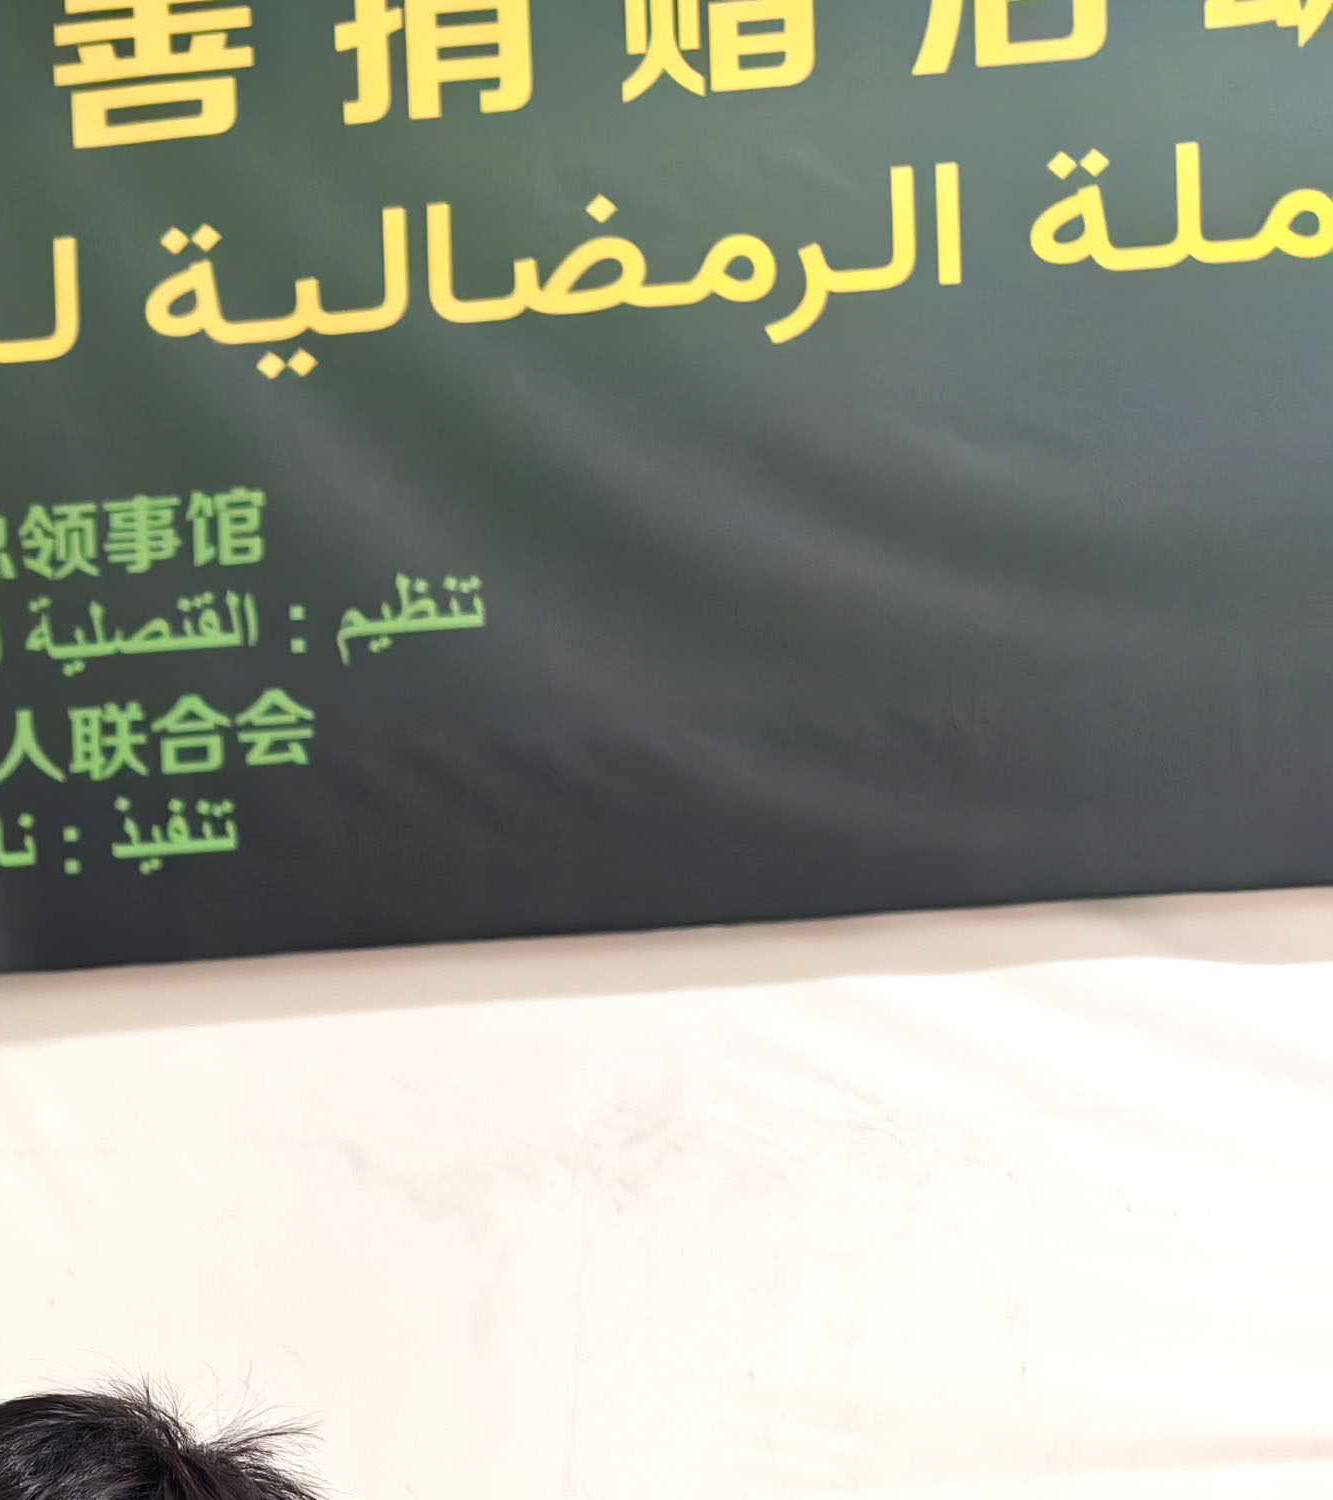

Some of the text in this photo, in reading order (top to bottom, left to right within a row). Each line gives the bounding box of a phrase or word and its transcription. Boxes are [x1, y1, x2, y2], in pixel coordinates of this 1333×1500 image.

[25, 589, 258, 677] القنصلية
[337, 572, 486, 666] تنظيم
[111, 796, 239, 875] تنفيذ
